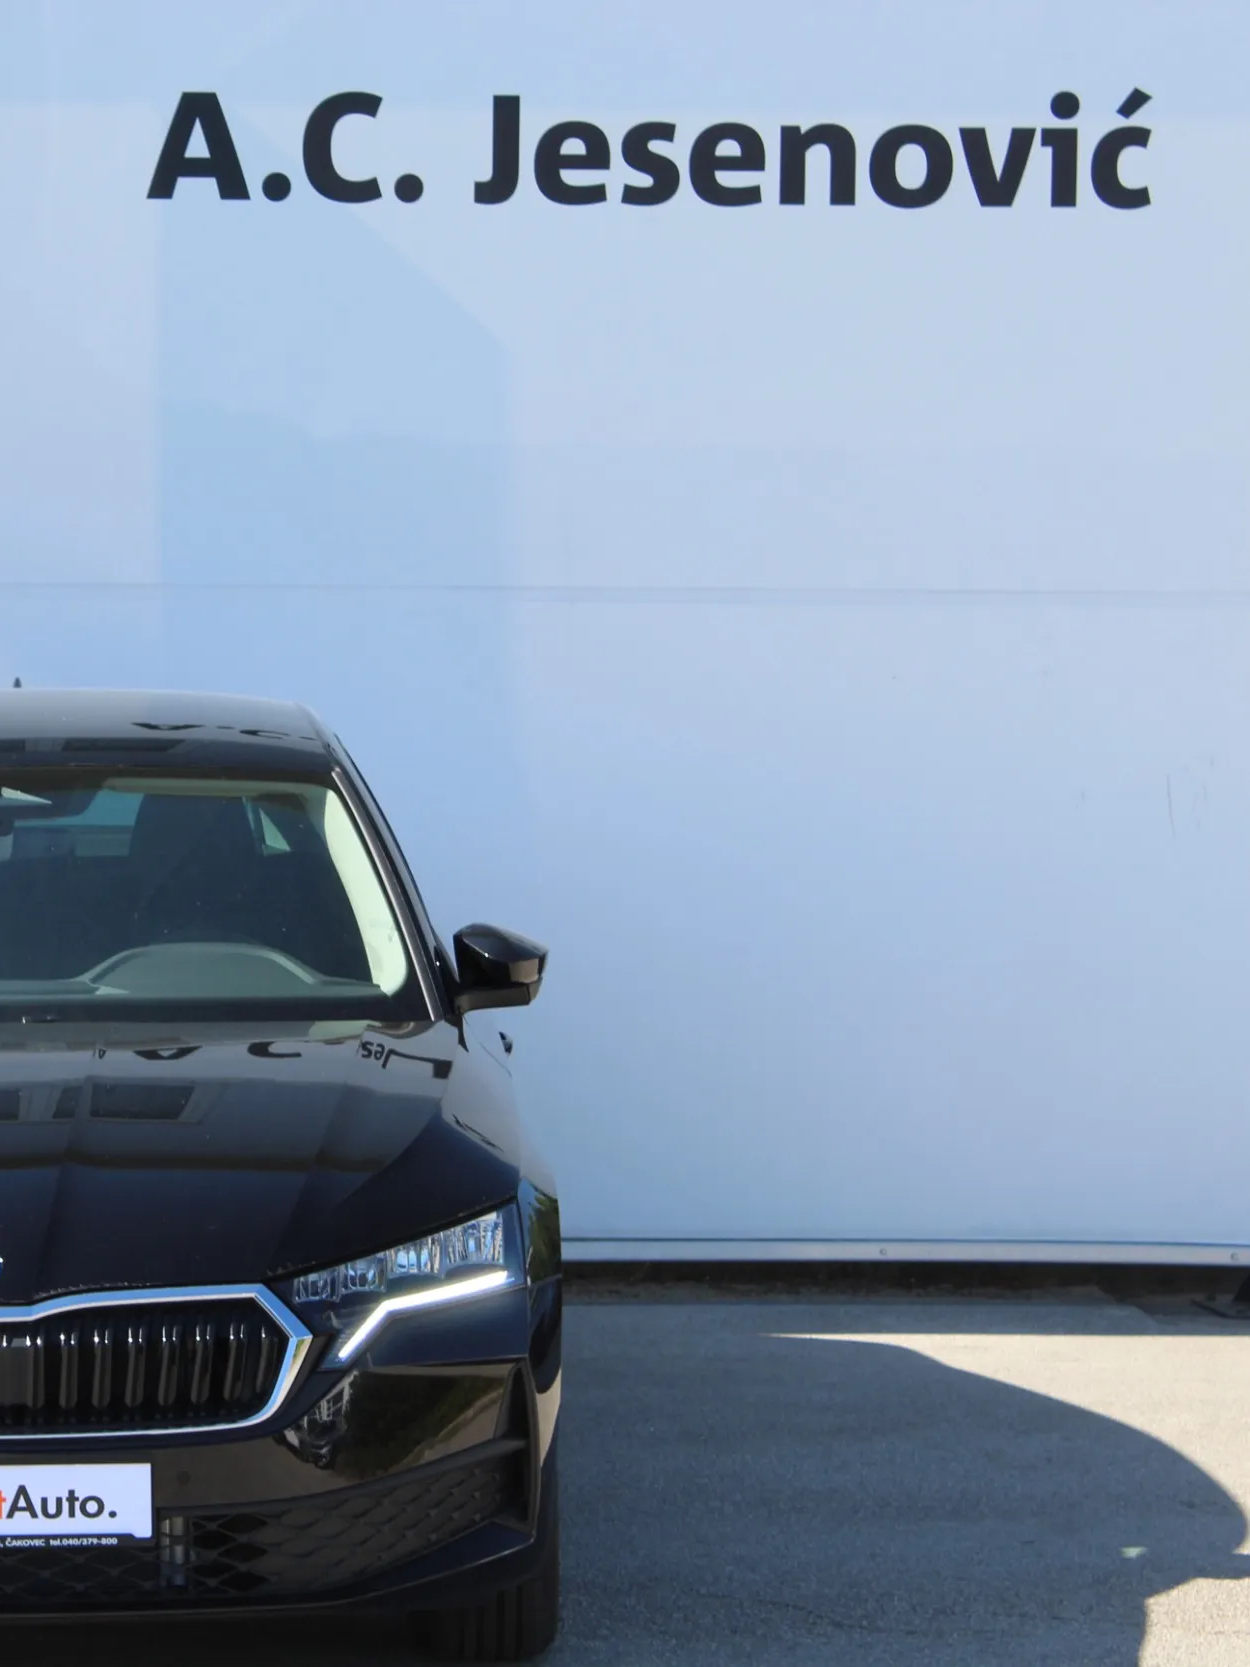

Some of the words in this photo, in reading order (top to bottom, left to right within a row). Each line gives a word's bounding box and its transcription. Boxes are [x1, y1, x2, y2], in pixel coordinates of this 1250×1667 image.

[146, 90, 425, 205] A.C.
[474, 86, 1153, 211] Jesenović
[5, 1537, 45, 1548] ČAKOVEC
